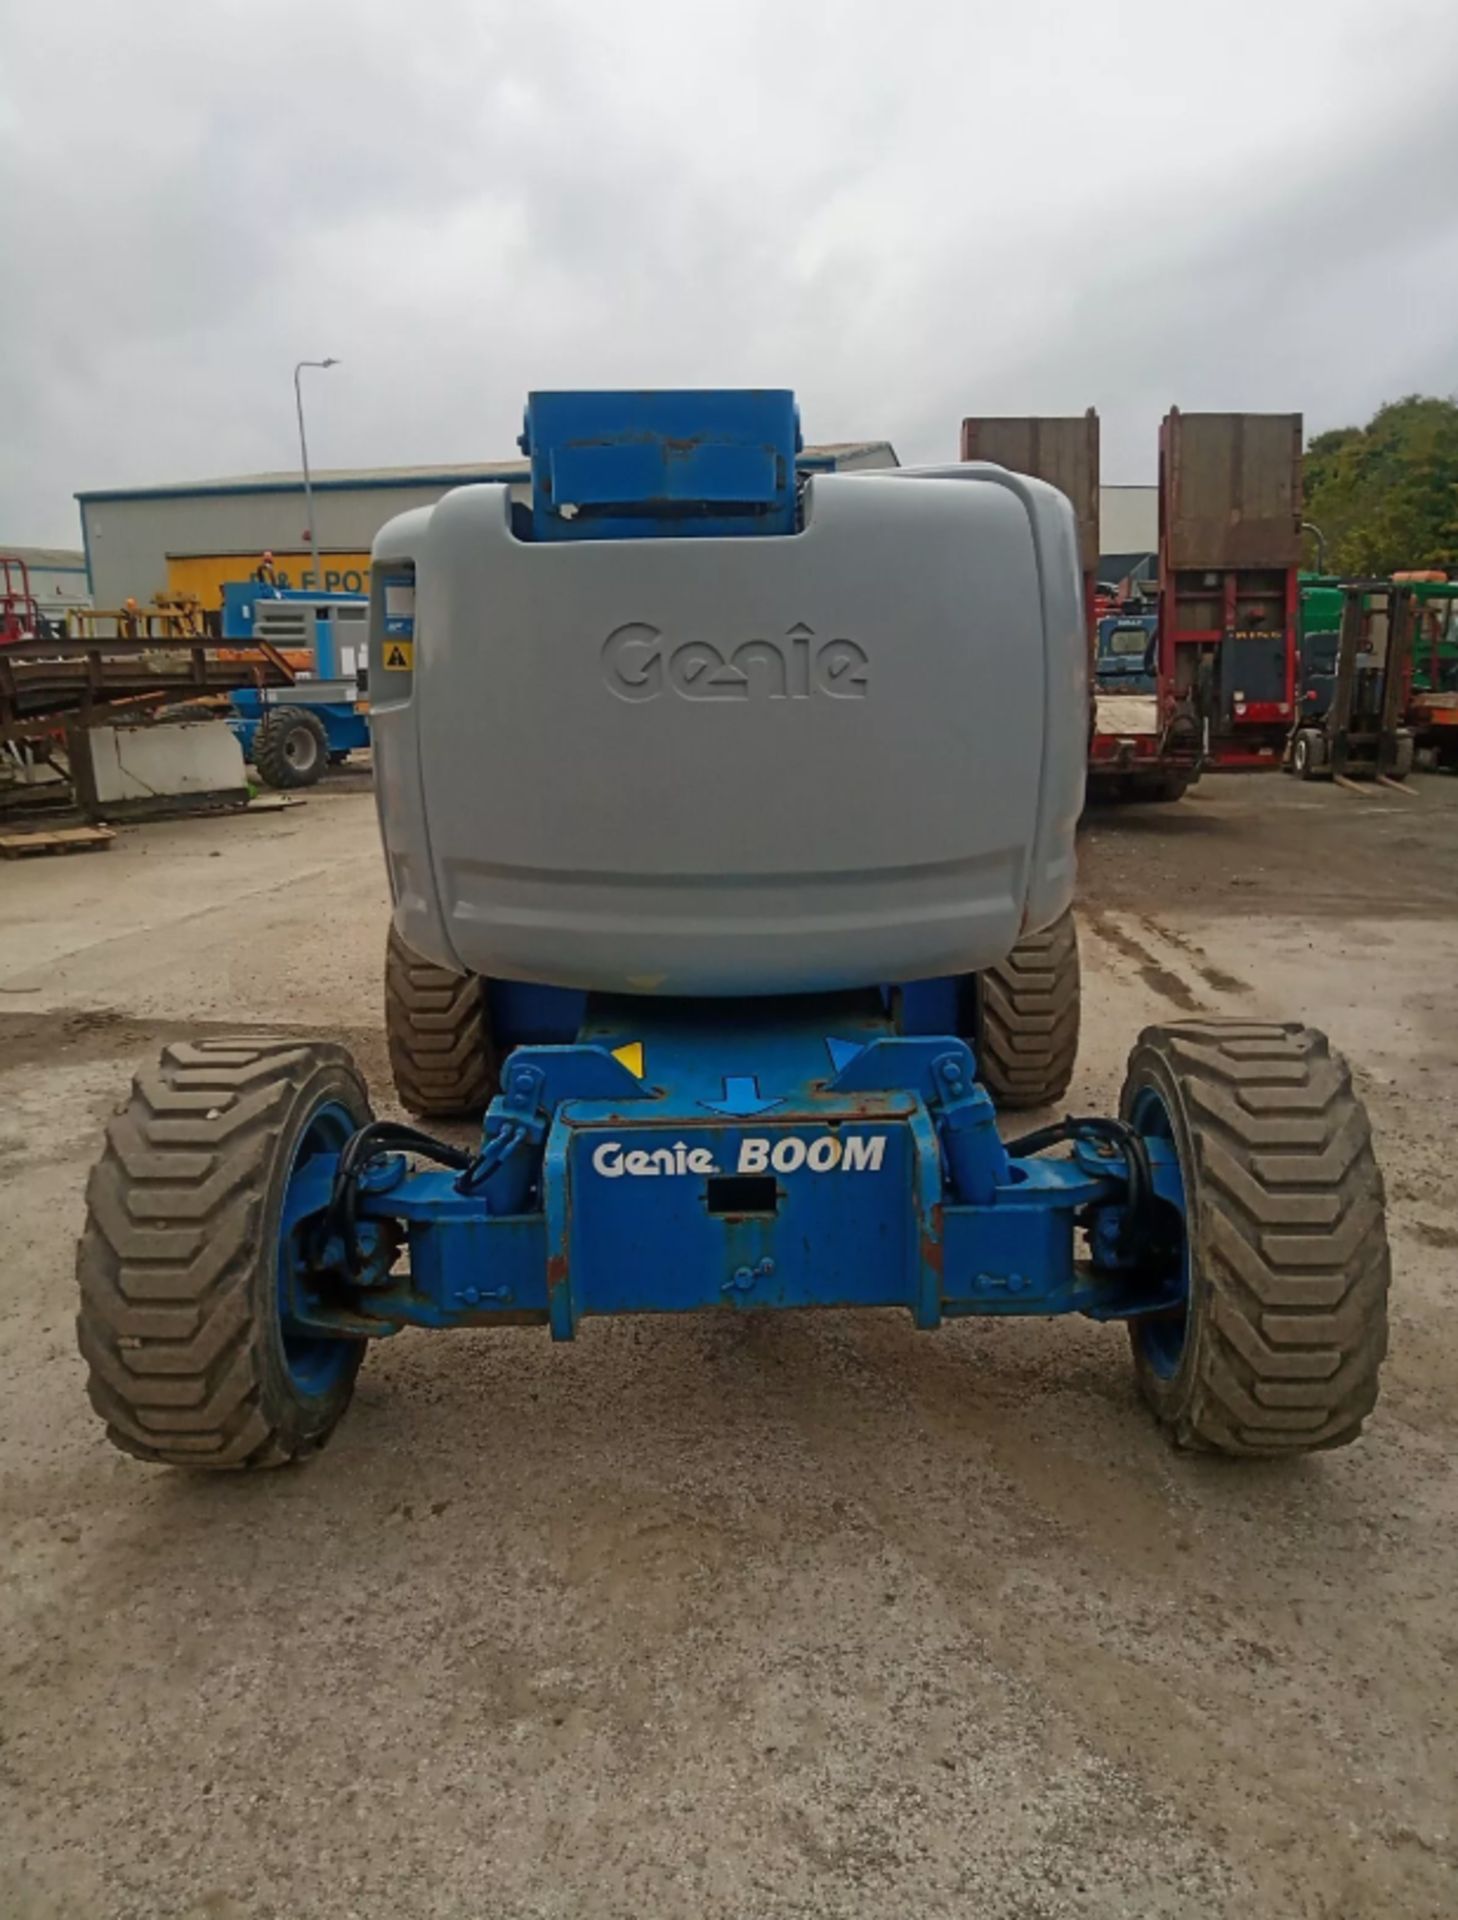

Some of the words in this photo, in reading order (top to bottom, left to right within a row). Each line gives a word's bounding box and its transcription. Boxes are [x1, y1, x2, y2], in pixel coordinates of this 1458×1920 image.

[325, 570, 369, 594] PO
[601, 621, 869, 703] Genie
[592, 1140, 714, 1177] Genie
[737, 1136, 887, 1173] BOOM
